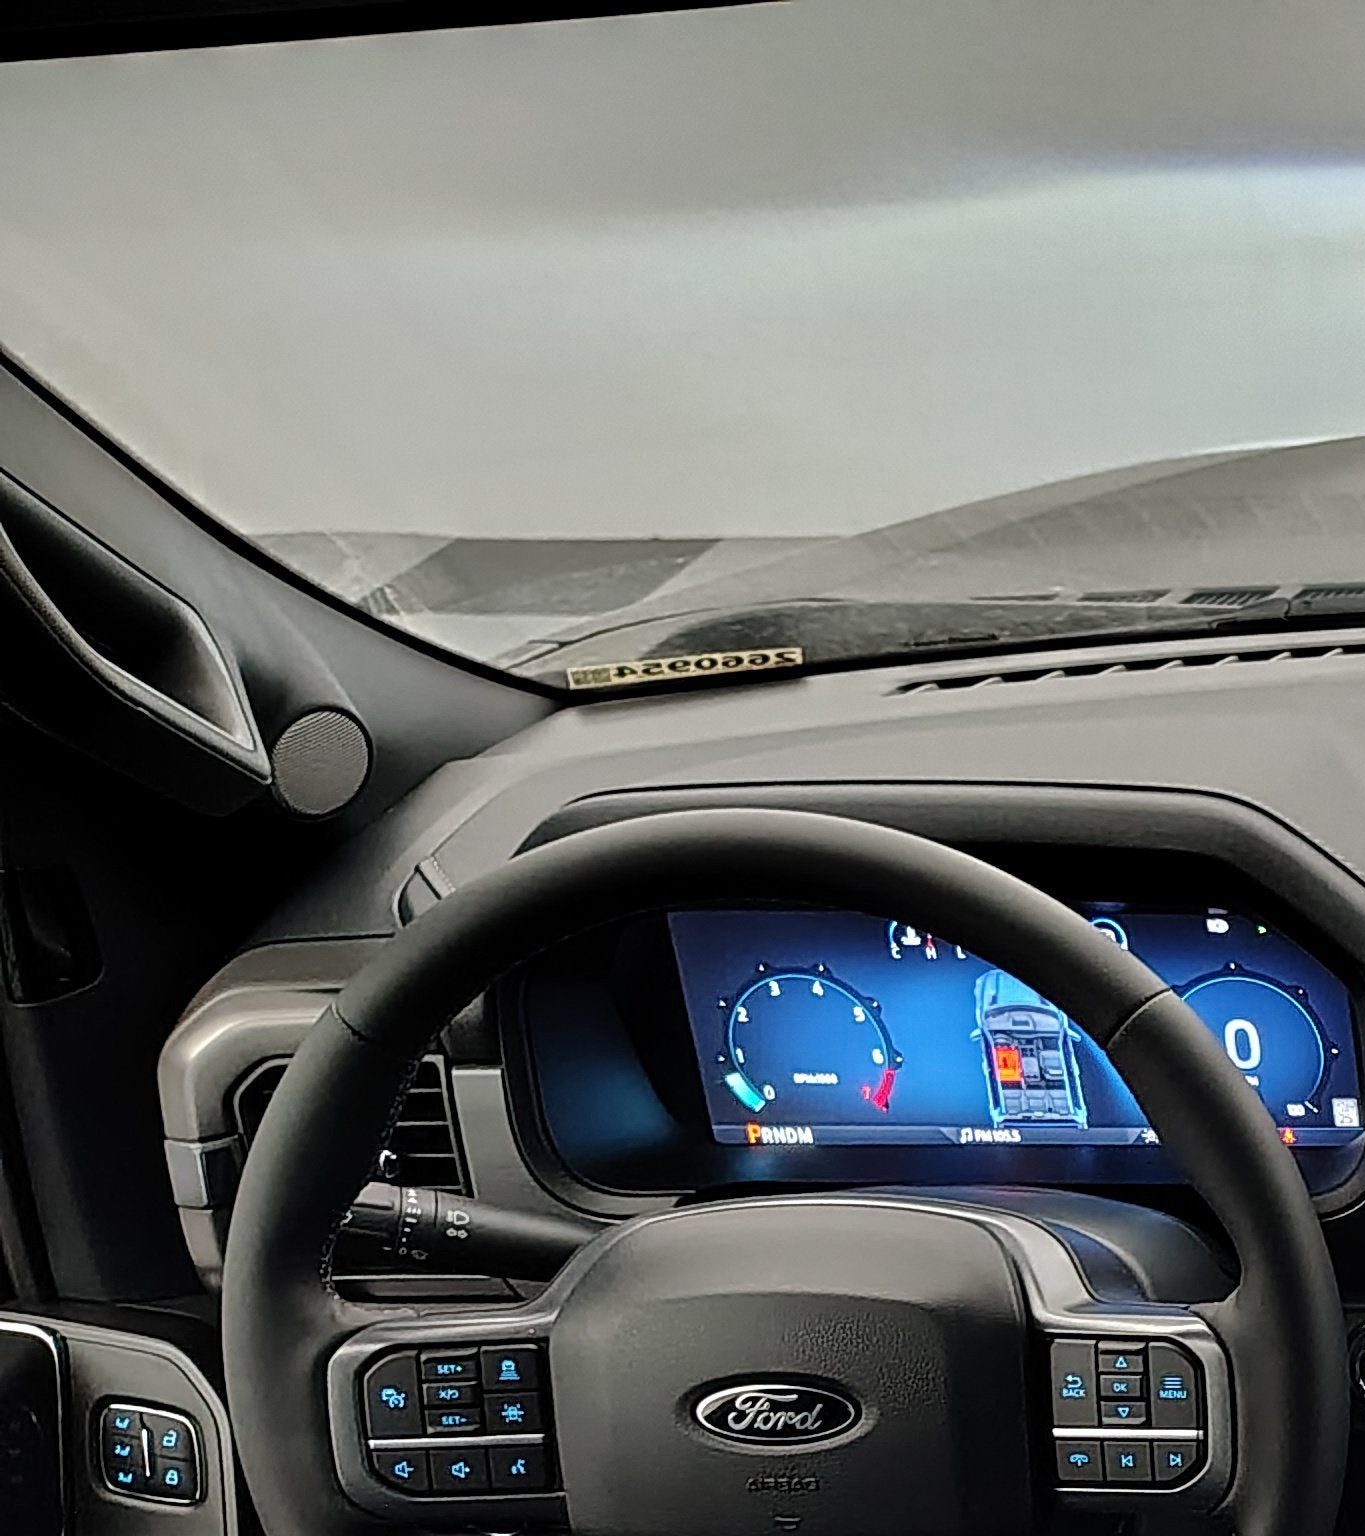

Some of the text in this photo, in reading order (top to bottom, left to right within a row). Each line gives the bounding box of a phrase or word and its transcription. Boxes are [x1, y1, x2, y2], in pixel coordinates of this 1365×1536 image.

[769, 980, 781, 997] 3
[812, 980, 824, 997] 4
[737, 1006, 749, 1022] 2
[853, 1006, 866, 1022] 5
[1224, 1018, 1261, 1070] 0
[736, 1048, 745, 1064] 1
[872, 1048, 884, 1065] 6
[763, 1085, 776, 1100] 0
[1062, 1388, 1087, 1398] BACK
[1113, 1382, 1128, 1393] OK
[1158, 1389, 1188, 1399] MENU
[727, 1393, 824, 1431] Ford
